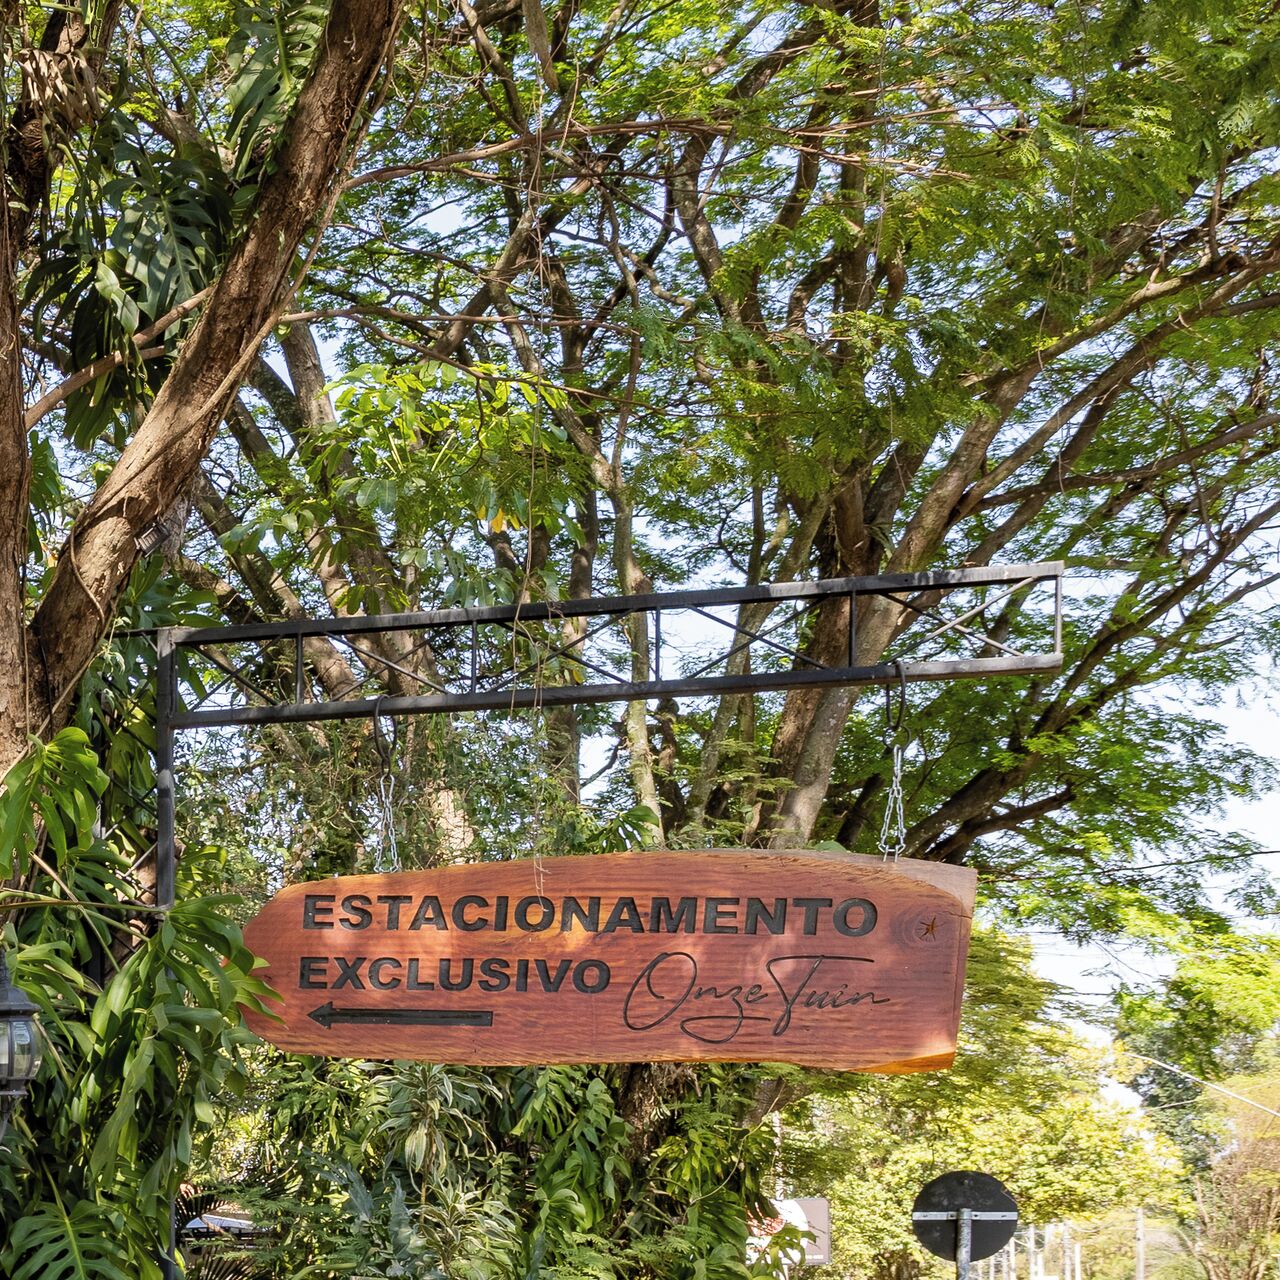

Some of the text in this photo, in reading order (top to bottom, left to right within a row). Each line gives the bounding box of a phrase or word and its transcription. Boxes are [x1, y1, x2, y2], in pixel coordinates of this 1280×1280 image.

[302, 894, 878, 937] ESTACIONAMENTO
[298, 951, 891, 1044] EXCLUSIVO Onze Tuin
